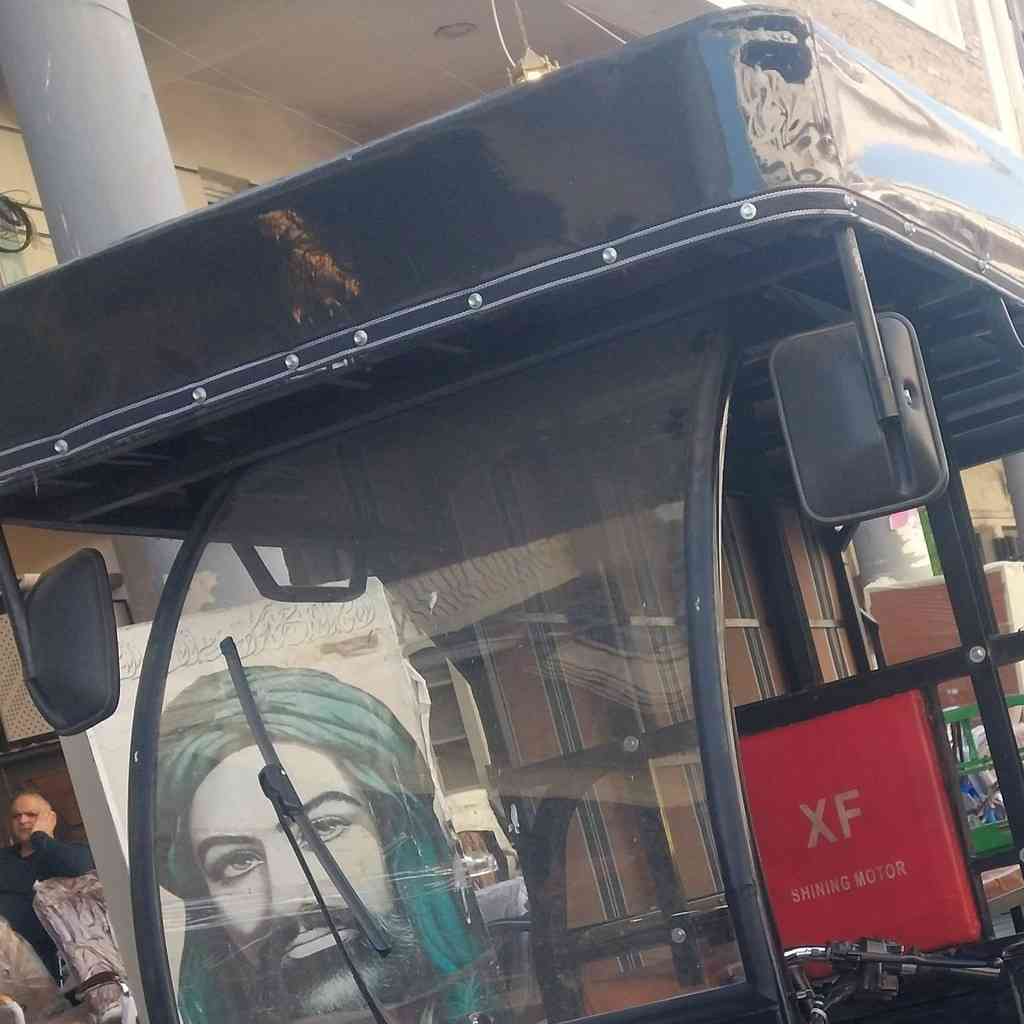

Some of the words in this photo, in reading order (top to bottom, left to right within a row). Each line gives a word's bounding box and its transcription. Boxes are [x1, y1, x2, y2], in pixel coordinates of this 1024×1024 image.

[799, 788, 861, 848] XF
[791, 875, 851, 903] SHINING
[853, 860, 907, 888] MOTOR
